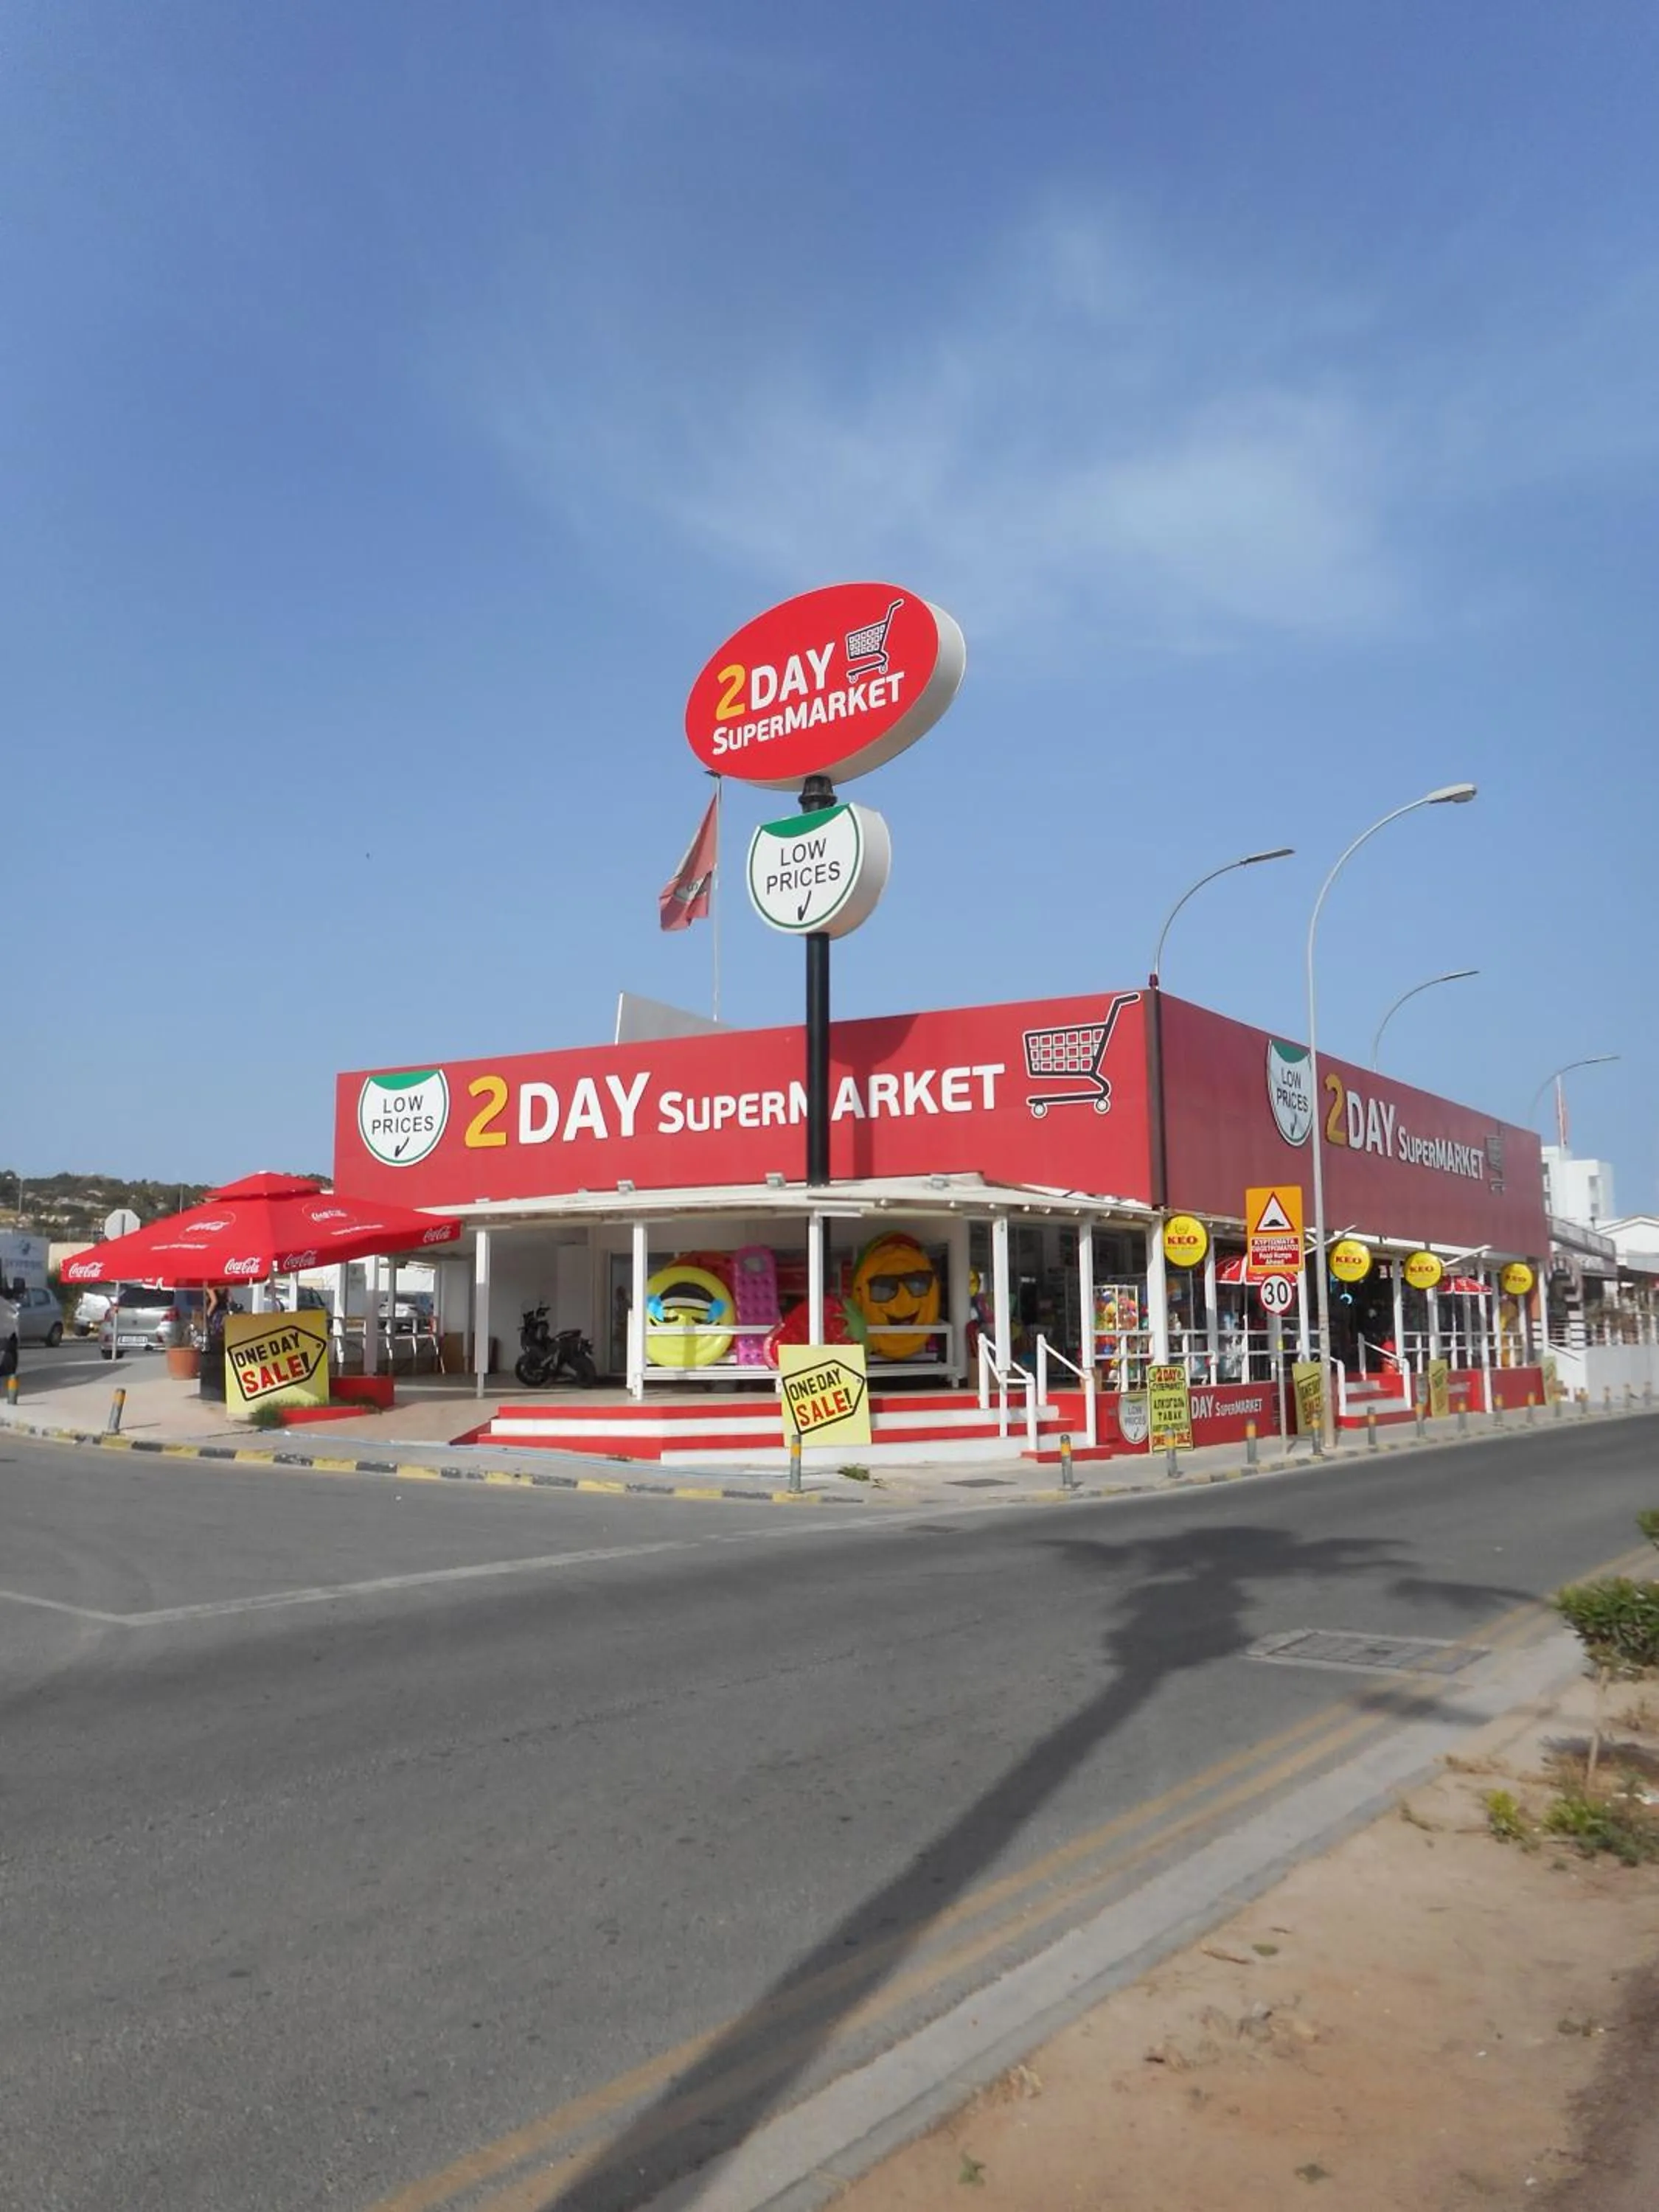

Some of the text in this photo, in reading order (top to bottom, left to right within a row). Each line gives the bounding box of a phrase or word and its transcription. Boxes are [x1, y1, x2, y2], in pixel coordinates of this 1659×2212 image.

[712, 672, 905, 755] SUPERMARKET
[780, 838, 827, 867] LOW
[767, 861, 841, 895] PRICES
[1281, 1067, 1301, 1089] LOW
[383, 1094, 424, 1114] LOW
[1276, 1087, 1309, 1114] PRICES
[372, 1115, 434, 1135] PRICES
[1397, 1126, 1484, 1180] SUPERMARKET
[1167, 1235, 1198, 1245] KEO
[1335, 1255, 1362, 1264] KEO
[1409, 1265, 1434, 1273] KEO
[1265, 1281, 1288, 1305] 30
[234, 1332, 299, 1368] ONE DAY
[242, 1352, 310, 1393] SALE!
[788, 1368, 842, 1401] ONE DAY
[796, 1388, 852, 1426] SALE!
[1191, 1395, 1214, 1419] DAY
